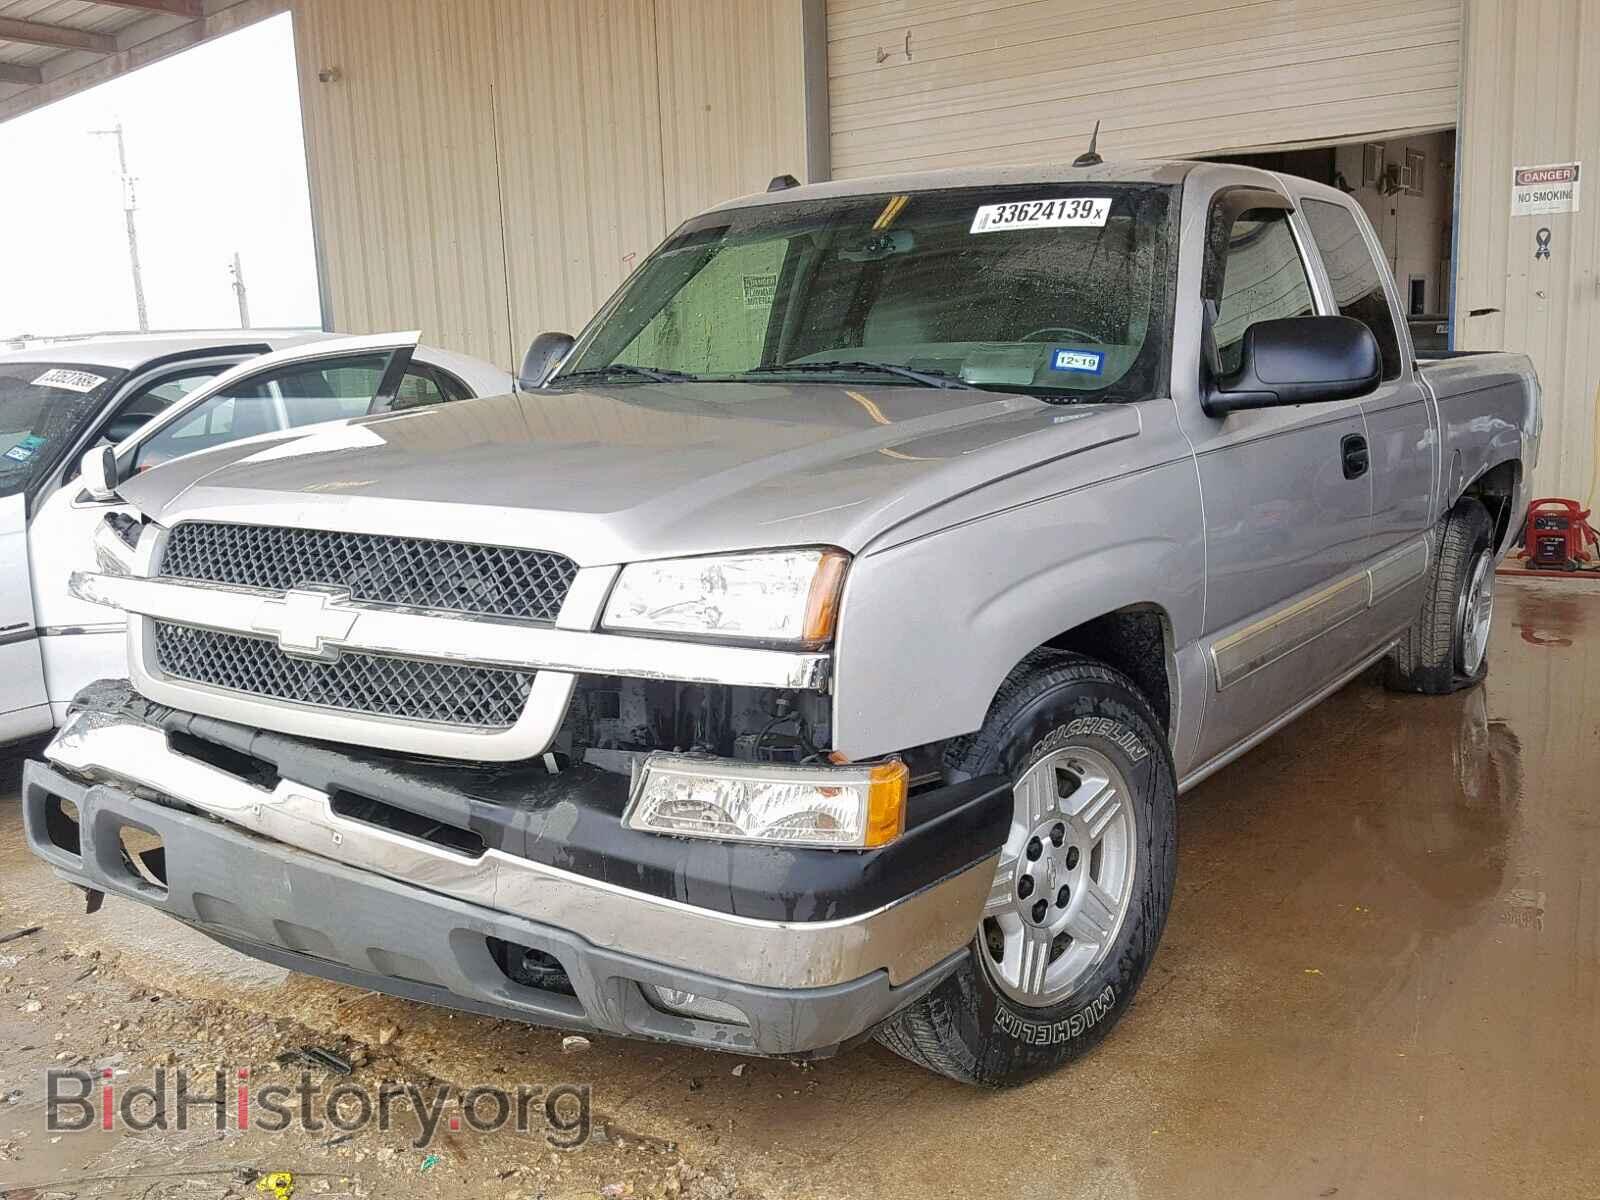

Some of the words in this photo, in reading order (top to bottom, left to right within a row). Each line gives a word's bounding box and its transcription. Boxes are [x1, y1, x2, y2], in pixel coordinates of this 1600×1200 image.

[1524, 170, 1571, 182] DANGER
[1518, 192, 1531, 203] NO
[1029, 716, 1149, 764] MICHELIN
[994, 985, 1116, 1045] MICHELIN
